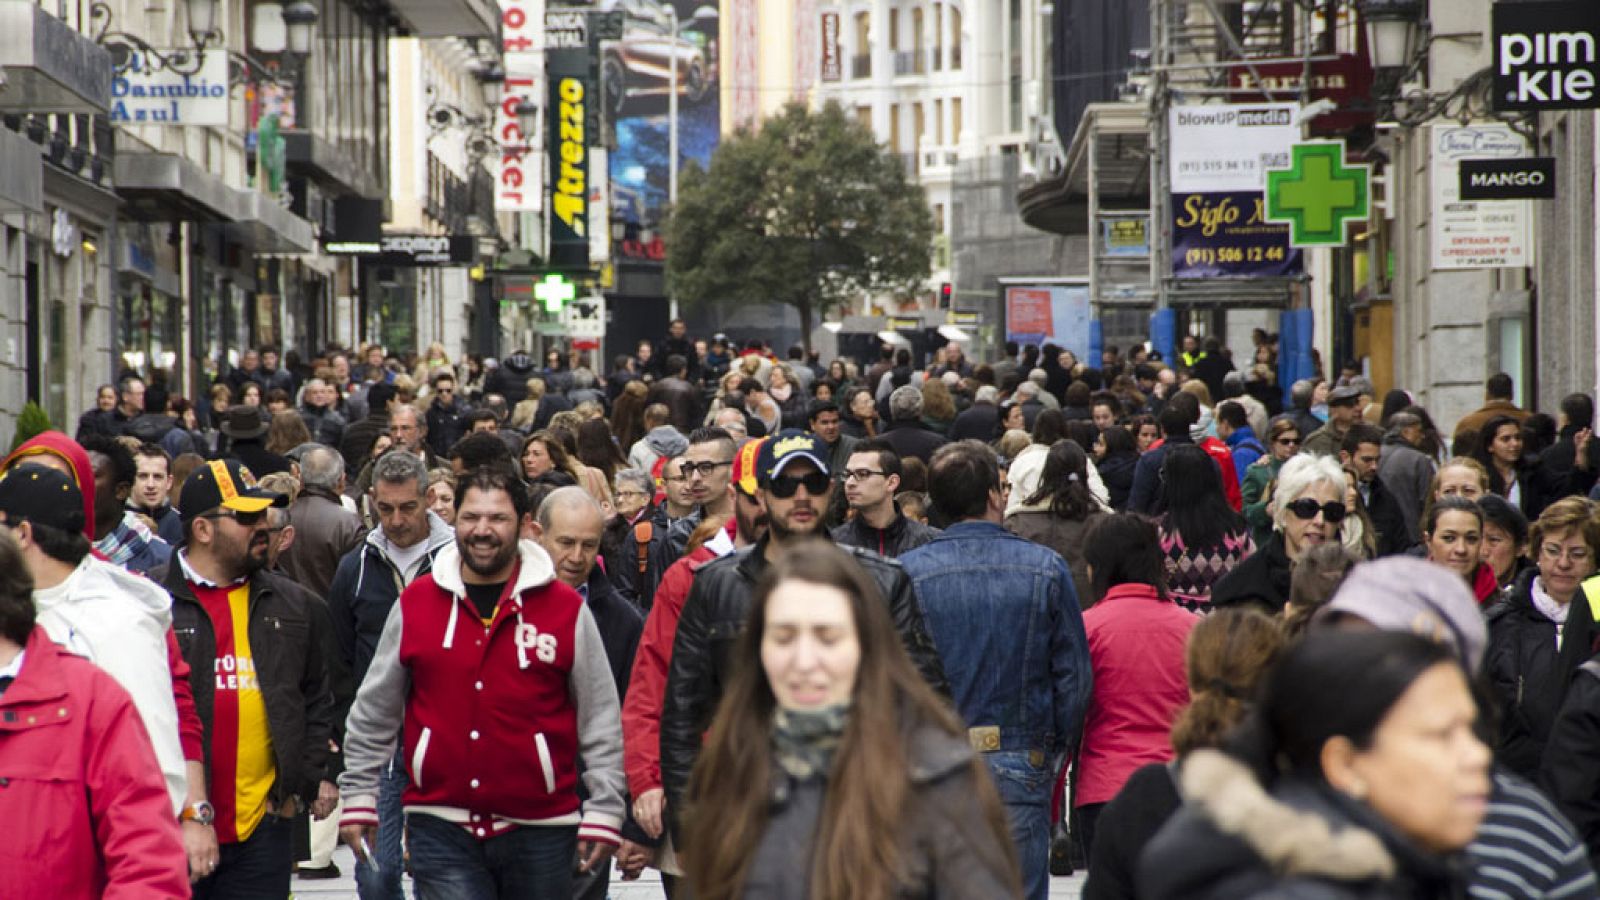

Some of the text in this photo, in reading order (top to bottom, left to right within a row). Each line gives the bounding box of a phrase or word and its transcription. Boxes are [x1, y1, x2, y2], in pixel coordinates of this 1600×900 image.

[1501, 31, 1595, 76] pim
[111, 77, 225, 98] Danubio
[111, 101, 181, 123] Azul
[1238, 108, 1291, 127] media
[502, 77, 534, 205] Locker
[553, 77, 585, 237] Atrezzo
[1471, 172, 1545, 187] MANGO
[1176, 195, 1239, 236] Siglo
[1186, 247, 1283, 265] (91) 506 12 44
